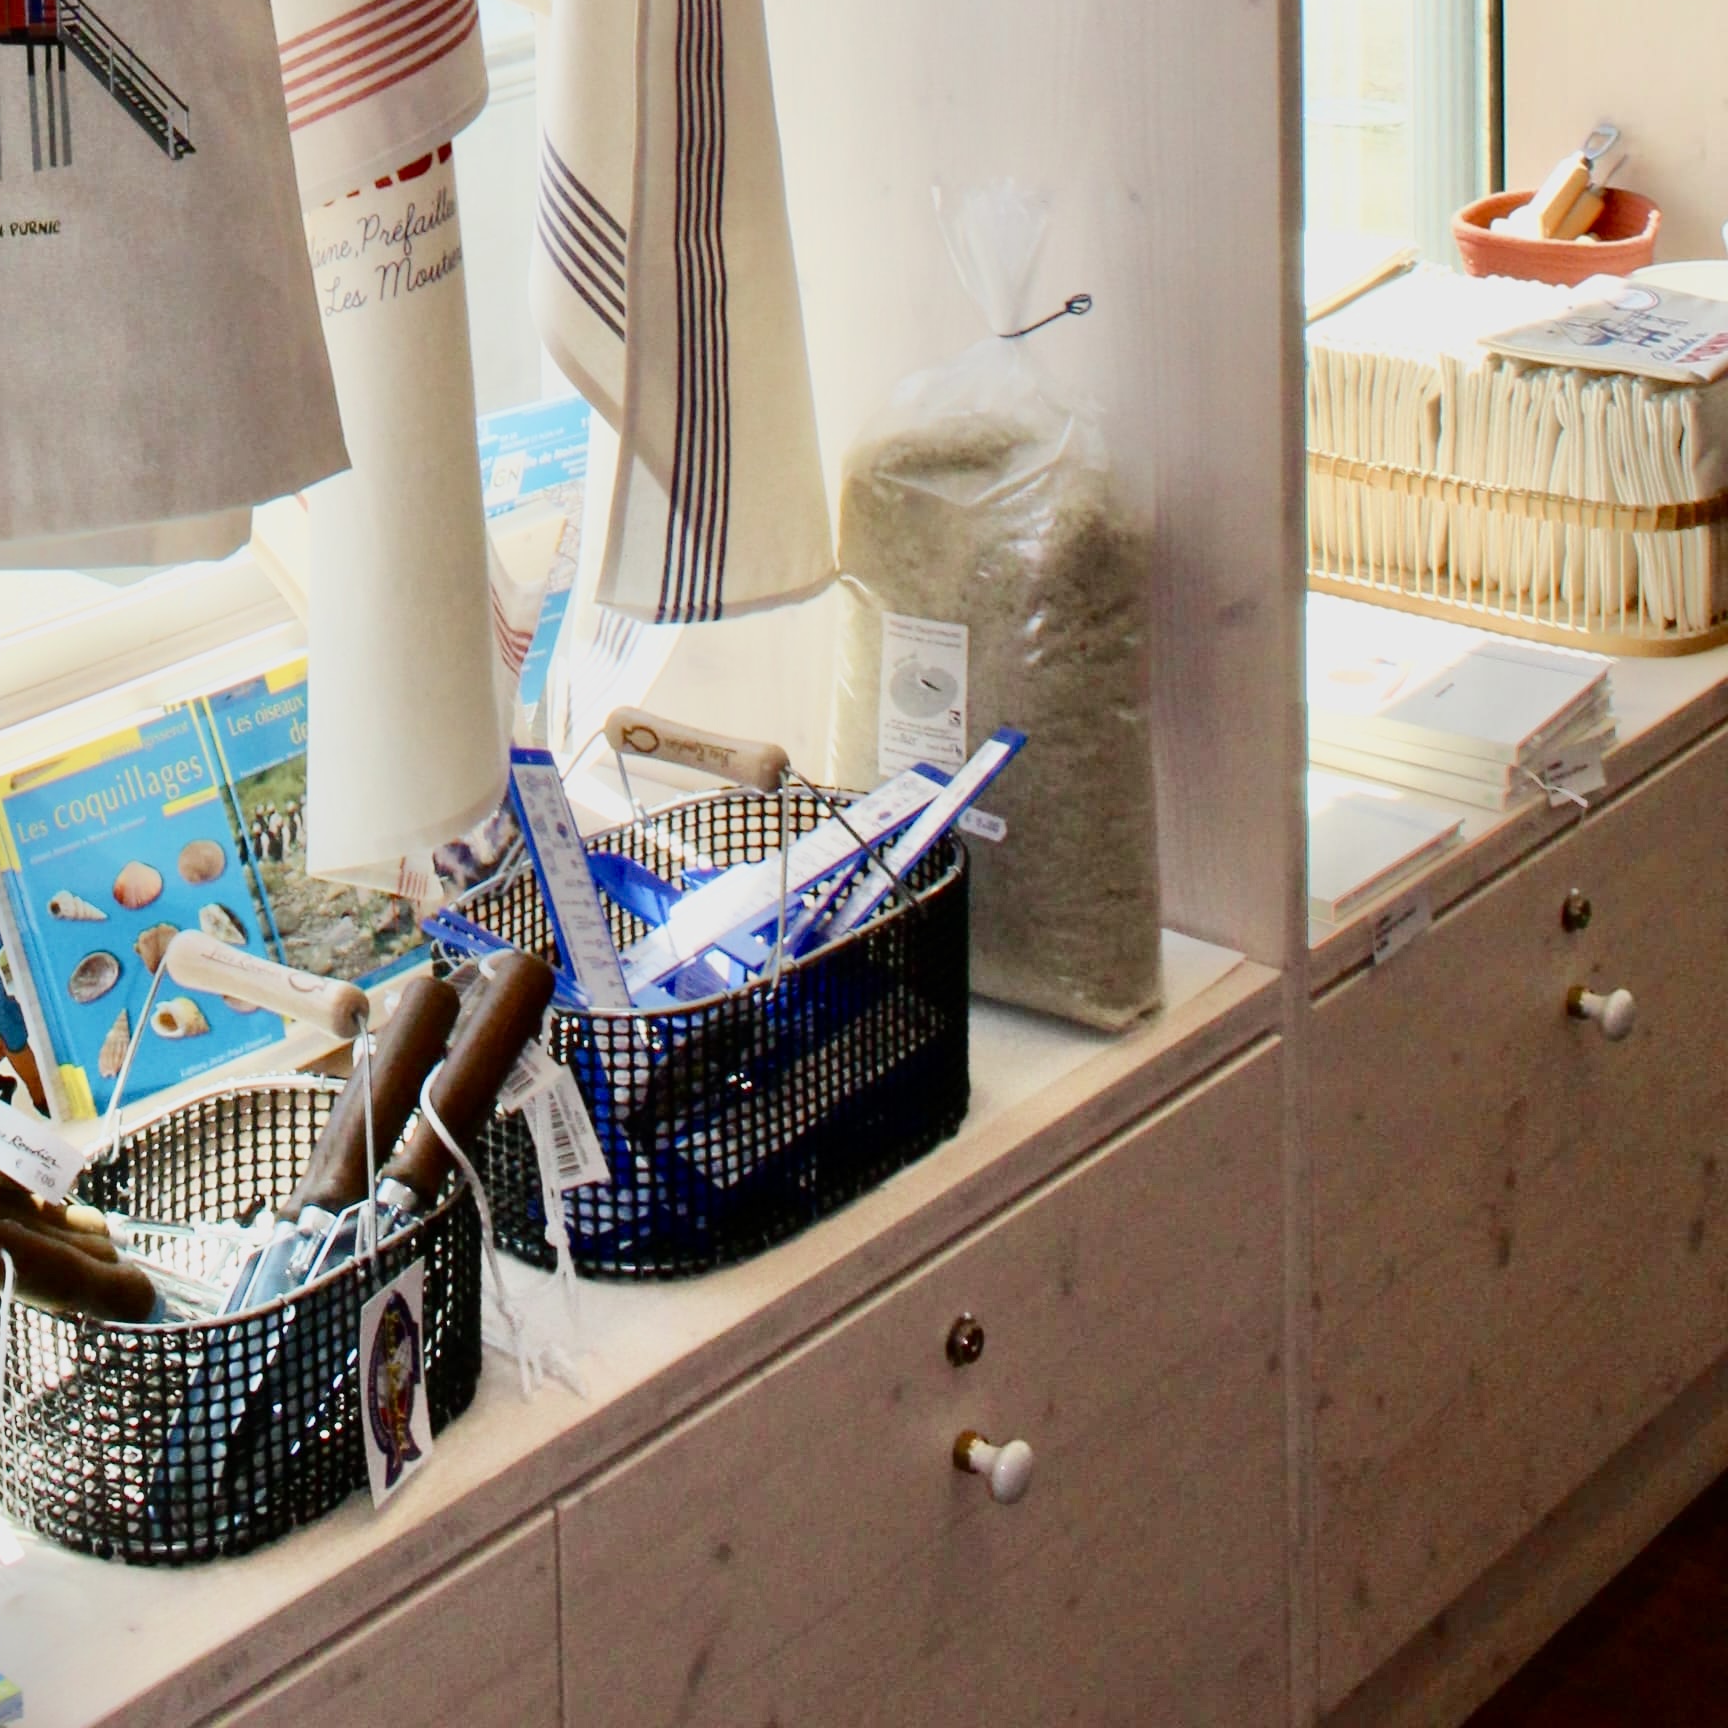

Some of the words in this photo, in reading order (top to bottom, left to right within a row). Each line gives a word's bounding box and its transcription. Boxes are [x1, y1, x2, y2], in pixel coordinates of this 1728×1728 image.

[9, 217, 62, 239] PORNIC
[324, 275, 369, 317] Les
[225, 713, 252, 737] Les
[254, 695, 305, 726] oiseaux
[15, 813, 49, 845] Les
[48, 743, 206, 839] coquillages
